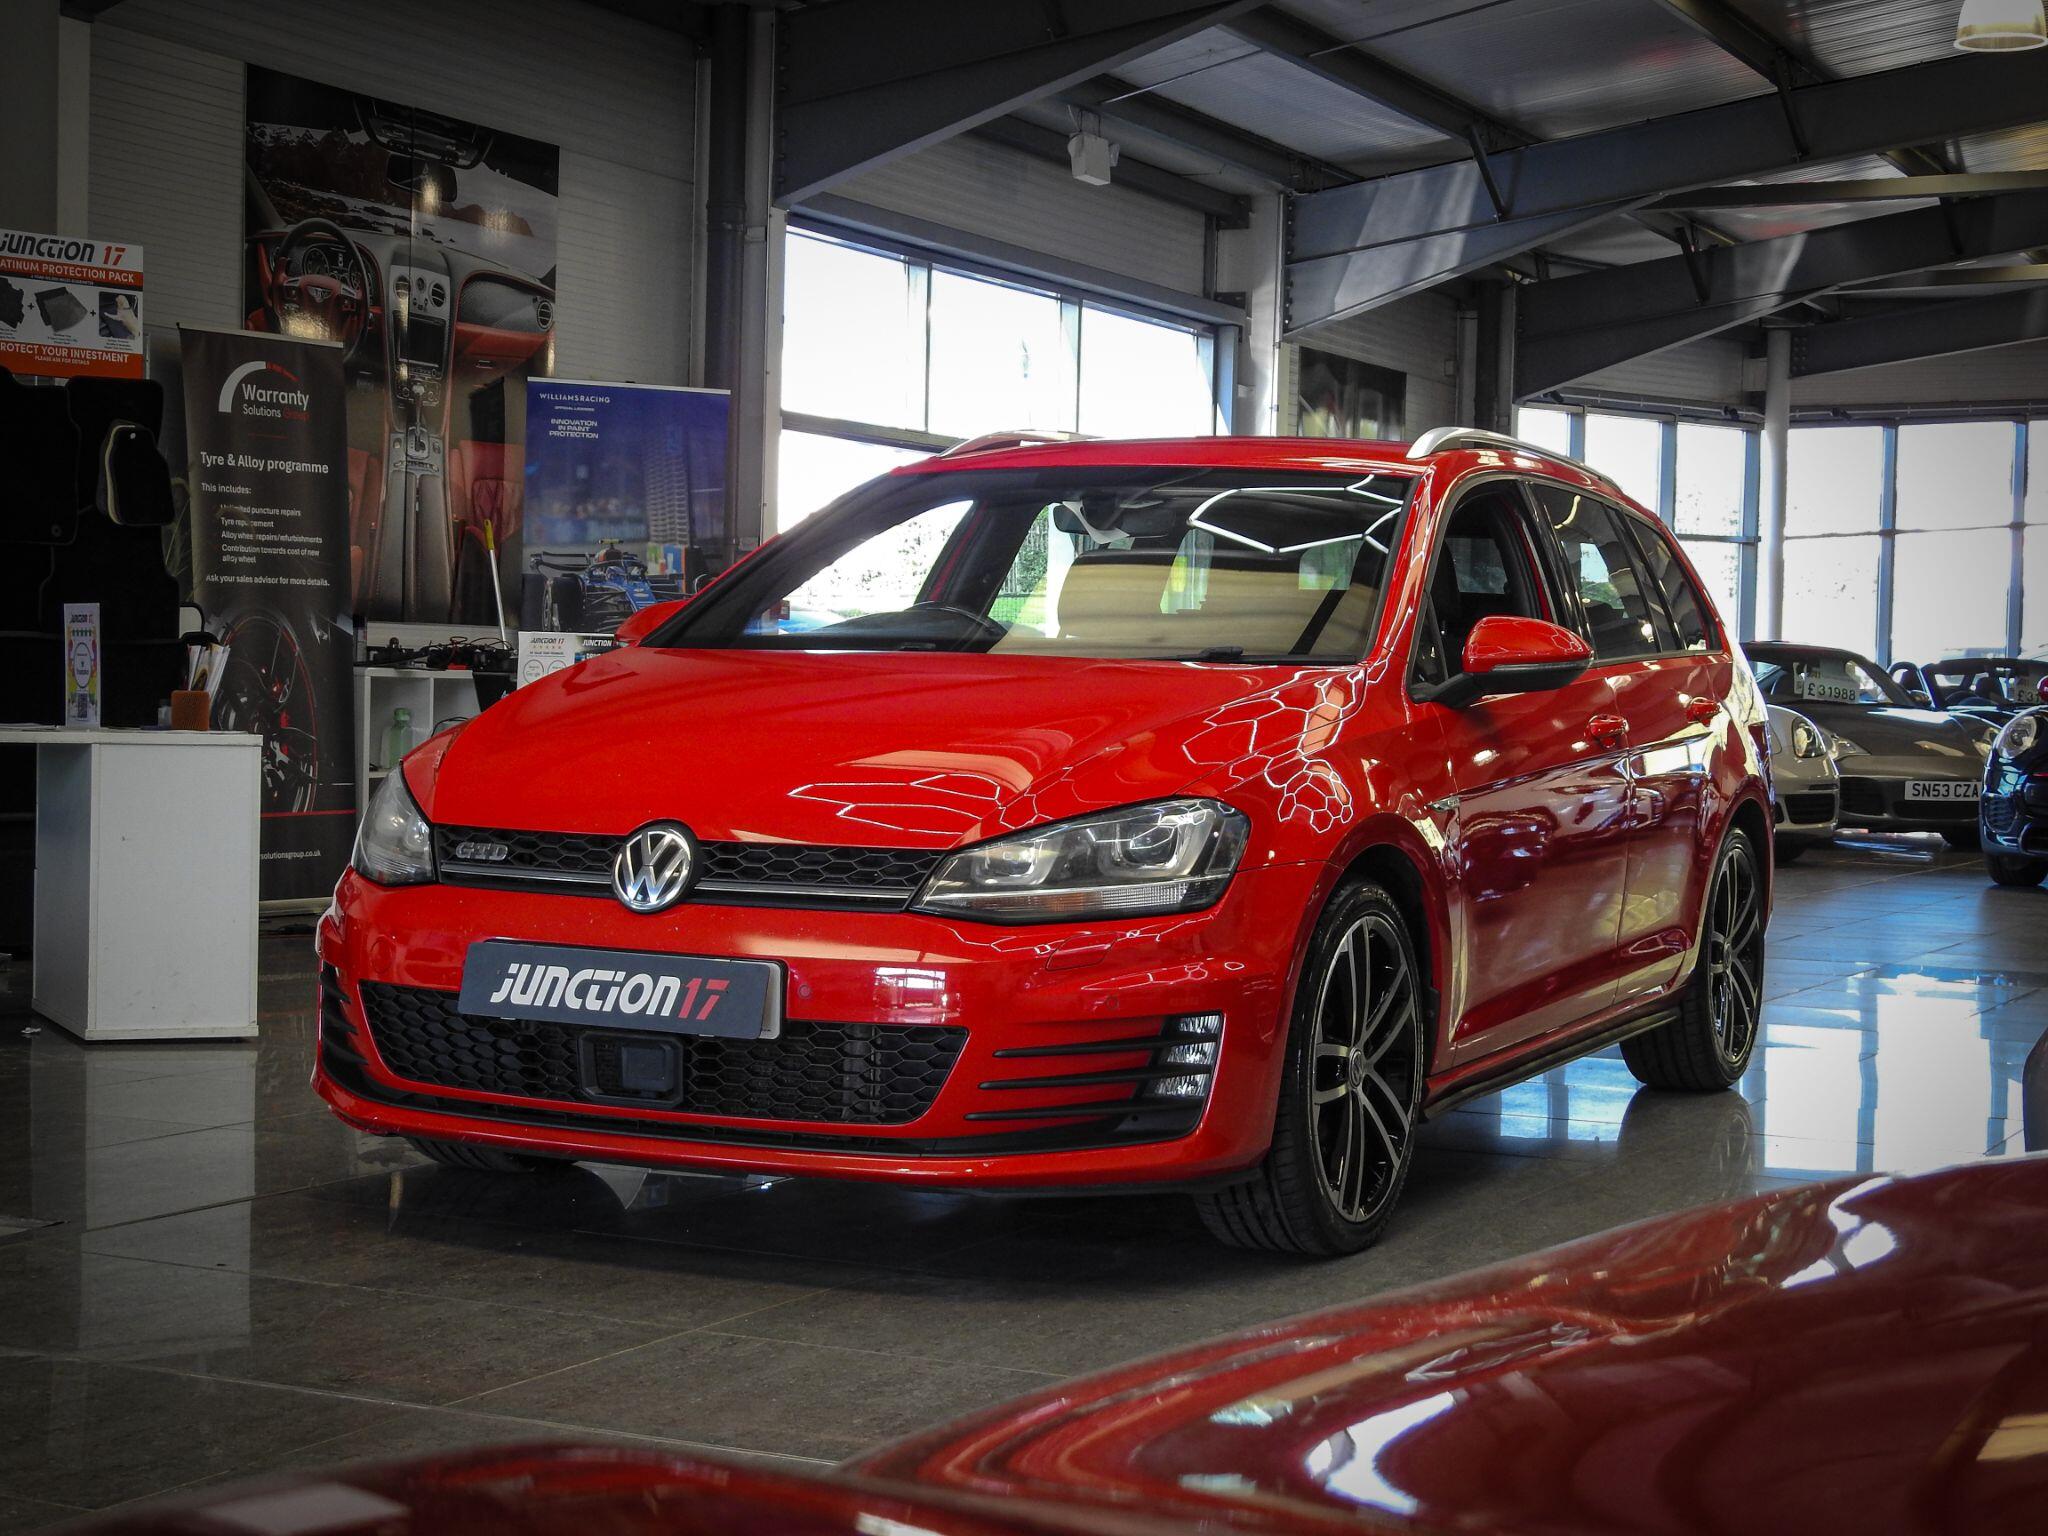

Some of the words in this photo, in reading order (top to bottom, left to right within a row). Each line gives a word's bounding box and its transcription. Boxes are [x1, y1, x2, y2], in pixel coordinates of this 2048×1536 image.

[0, 233, 95, 262] JUNCTION
[103, 245, 126, 266] 17
[42, 262, 106, 279] PROTECTION
[109, 271, 134, 282] PACK
[42, 346, 68, 358] YOUR
[71, 349, 129, 363] INVESTMENT
[242, 383, 309, 411] Warranty
[242, 403, 282, 418] Solutions
[550, 418, 598, 427] INNOVATION
[549, 430, 599, 439] PROTECTION
[200, 451, 225, 468] Tyre
[227, 453, 235, 466] &
[238, 454, 265, 471] Alloy
[267, 459, 329, 474] programme
[201, 482, 216, 493] This
[218, 483, 252, 495] includes:
[251, 506, 280, 517] puncture
[281, 508, 302, 518] repairs
[220, 517, 234, 527] Tyre
[221, 530, 237, 540] Alloy
[238, 532, 254, 541] whee
[255, 534, 323, 545] repairs/refurbishments
[221, 544, 260, 554] Contribution
[261, 547, 286, 556] towards
[287, 548, 300, 556] cost
[222, 555, 238, 564] alloy
[238, 555, 257, 563] wheel
[206, 573, 219, 582] Ask
[219, 575, 235, 583] your
[236, 575, 253, 583] sales
[253, 576, 278, 584] advisor
[582, 639, 612, 647] JUNCTION
[1807, 683, 1856, 701] £31988
[1912, 783, 1950, 798] SN53
[1954, 783, 1979, 798] CZA
[456, 841, 508, 861] GTD
